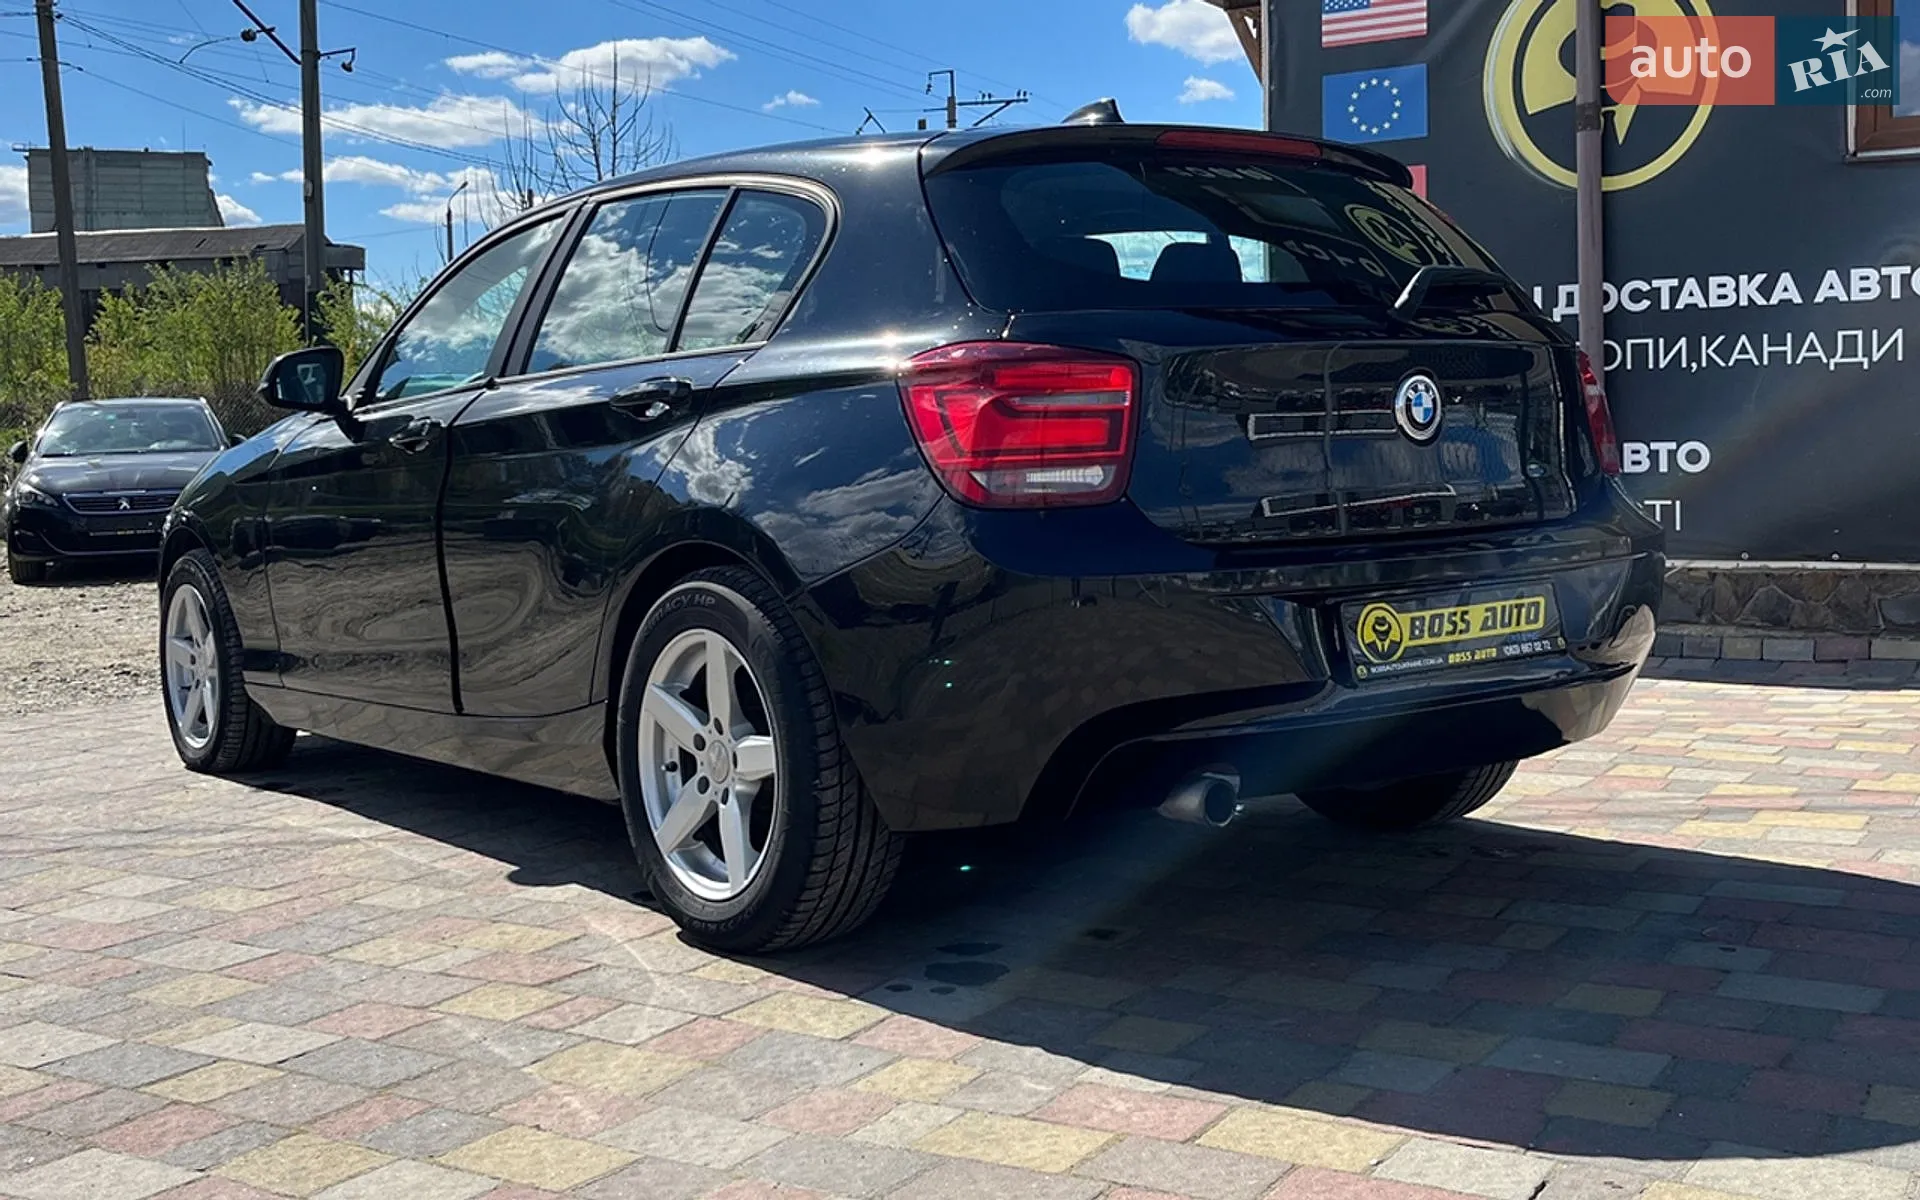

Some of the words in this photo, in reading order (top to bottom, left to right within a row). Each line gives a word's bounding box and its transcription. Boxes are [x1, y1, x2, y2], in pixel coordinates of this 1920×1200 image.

[1813, 265, 1920, 303] АВТ
[1576, 328, 1904, 374] ОПИ,КАНАДИ
[1618, 441, 1711, 473] ВТО
[693, 594, 716, 607] HP
[1409, 609, 1471, 640] BOSS
[1480, 601, 1542, 630] AUTO
[1448, 651, 1472, 664] BOSS
[1474, 647, 1497, 660] AUTO
